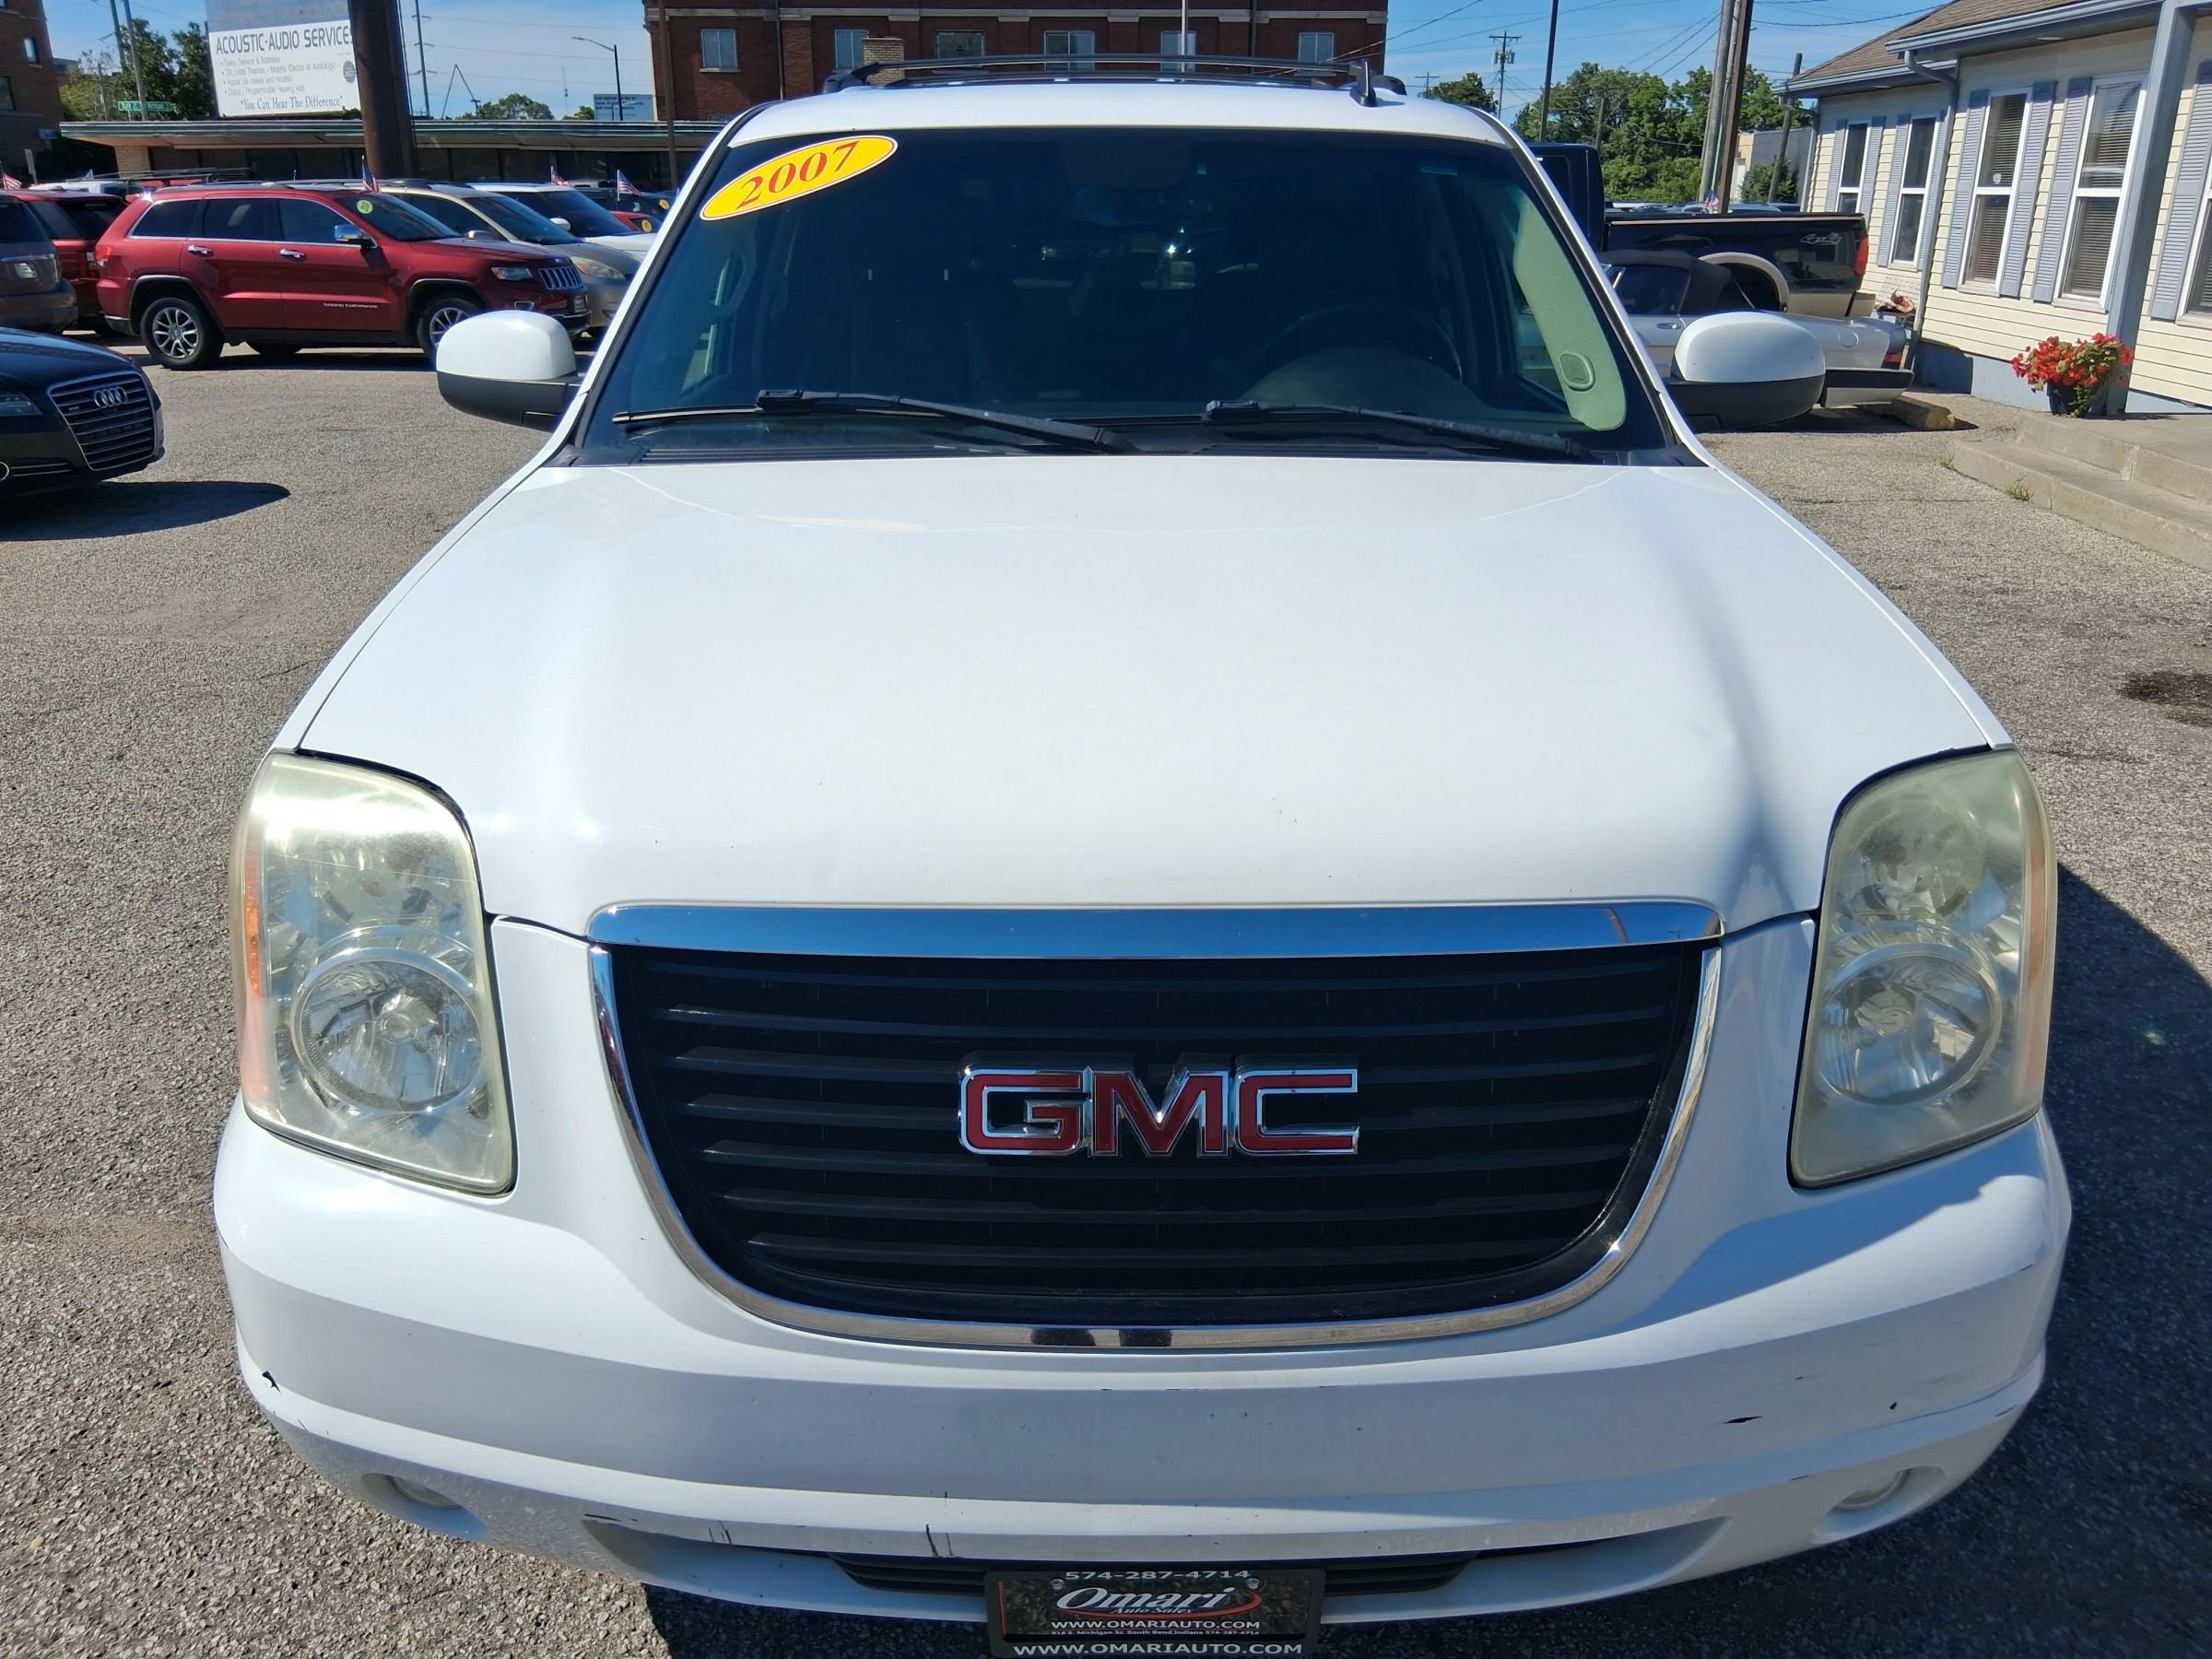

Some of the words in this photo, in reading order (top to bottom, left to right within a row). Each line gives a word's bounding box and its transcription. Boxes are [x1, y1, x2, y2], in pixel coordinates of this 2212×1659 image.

[257, 98, 270, 110] Can
[272, 98, 288, 109] Hear
[289, 96, 303, 109] The
[735, 140, 861, 210] 2007
[959, 1065, 1360, 1159] GMC
[1065, 1570, 1251, 1581] 574-287-4714
[1056, 1587, 1236, 1609] Omari
[1051, 1620, 1261, 1629] WWW.OMARIAUTO.COM
[1014, 1643, 1302, 1655] WWW.OMARIAUTO.COM
